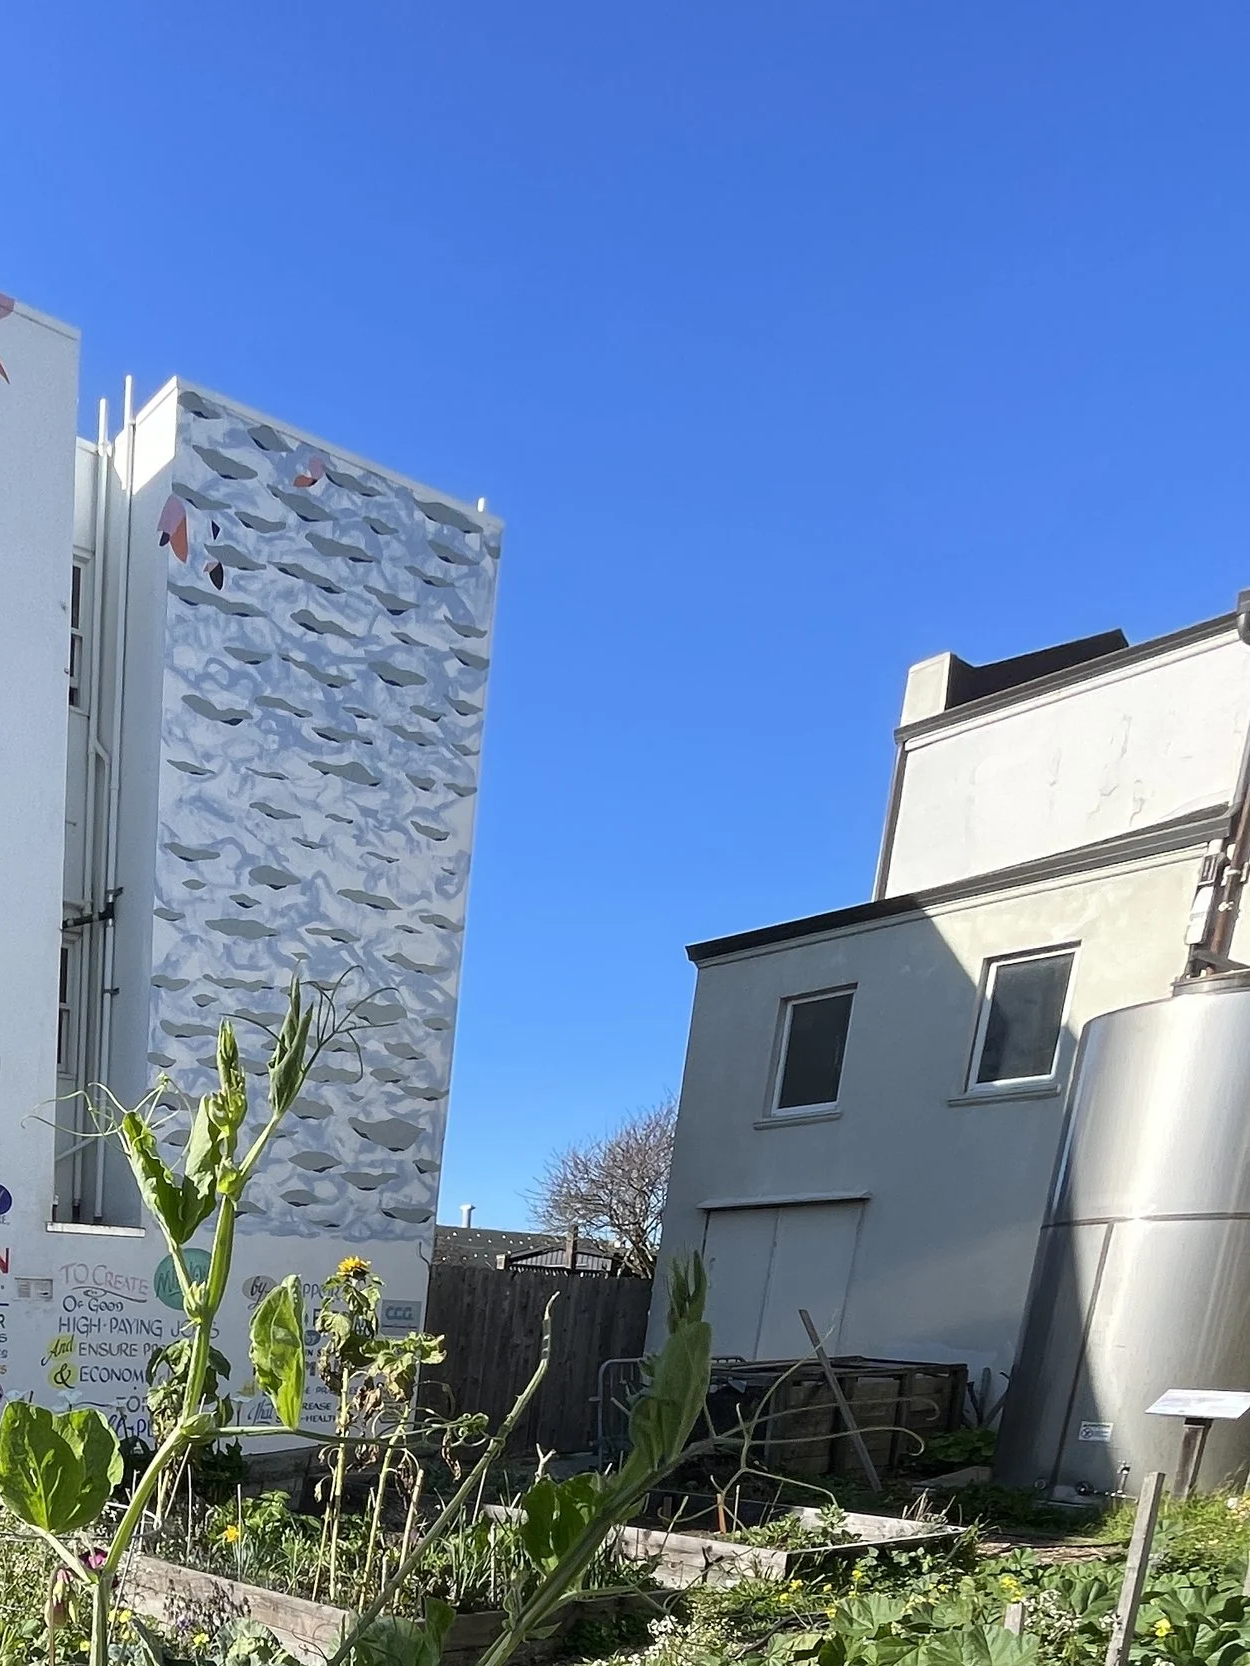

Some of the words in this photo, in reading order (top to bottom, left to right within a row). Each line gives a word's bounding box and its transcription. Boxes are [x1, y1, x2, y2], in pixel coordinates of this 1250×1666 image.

[61, 1264, 88, 1284] TO
[93, 1265, 148, 1295] CREATE
[171, 1320, 220, 1339] JOS
[79, 1342, 137, 1357] ENSURE
